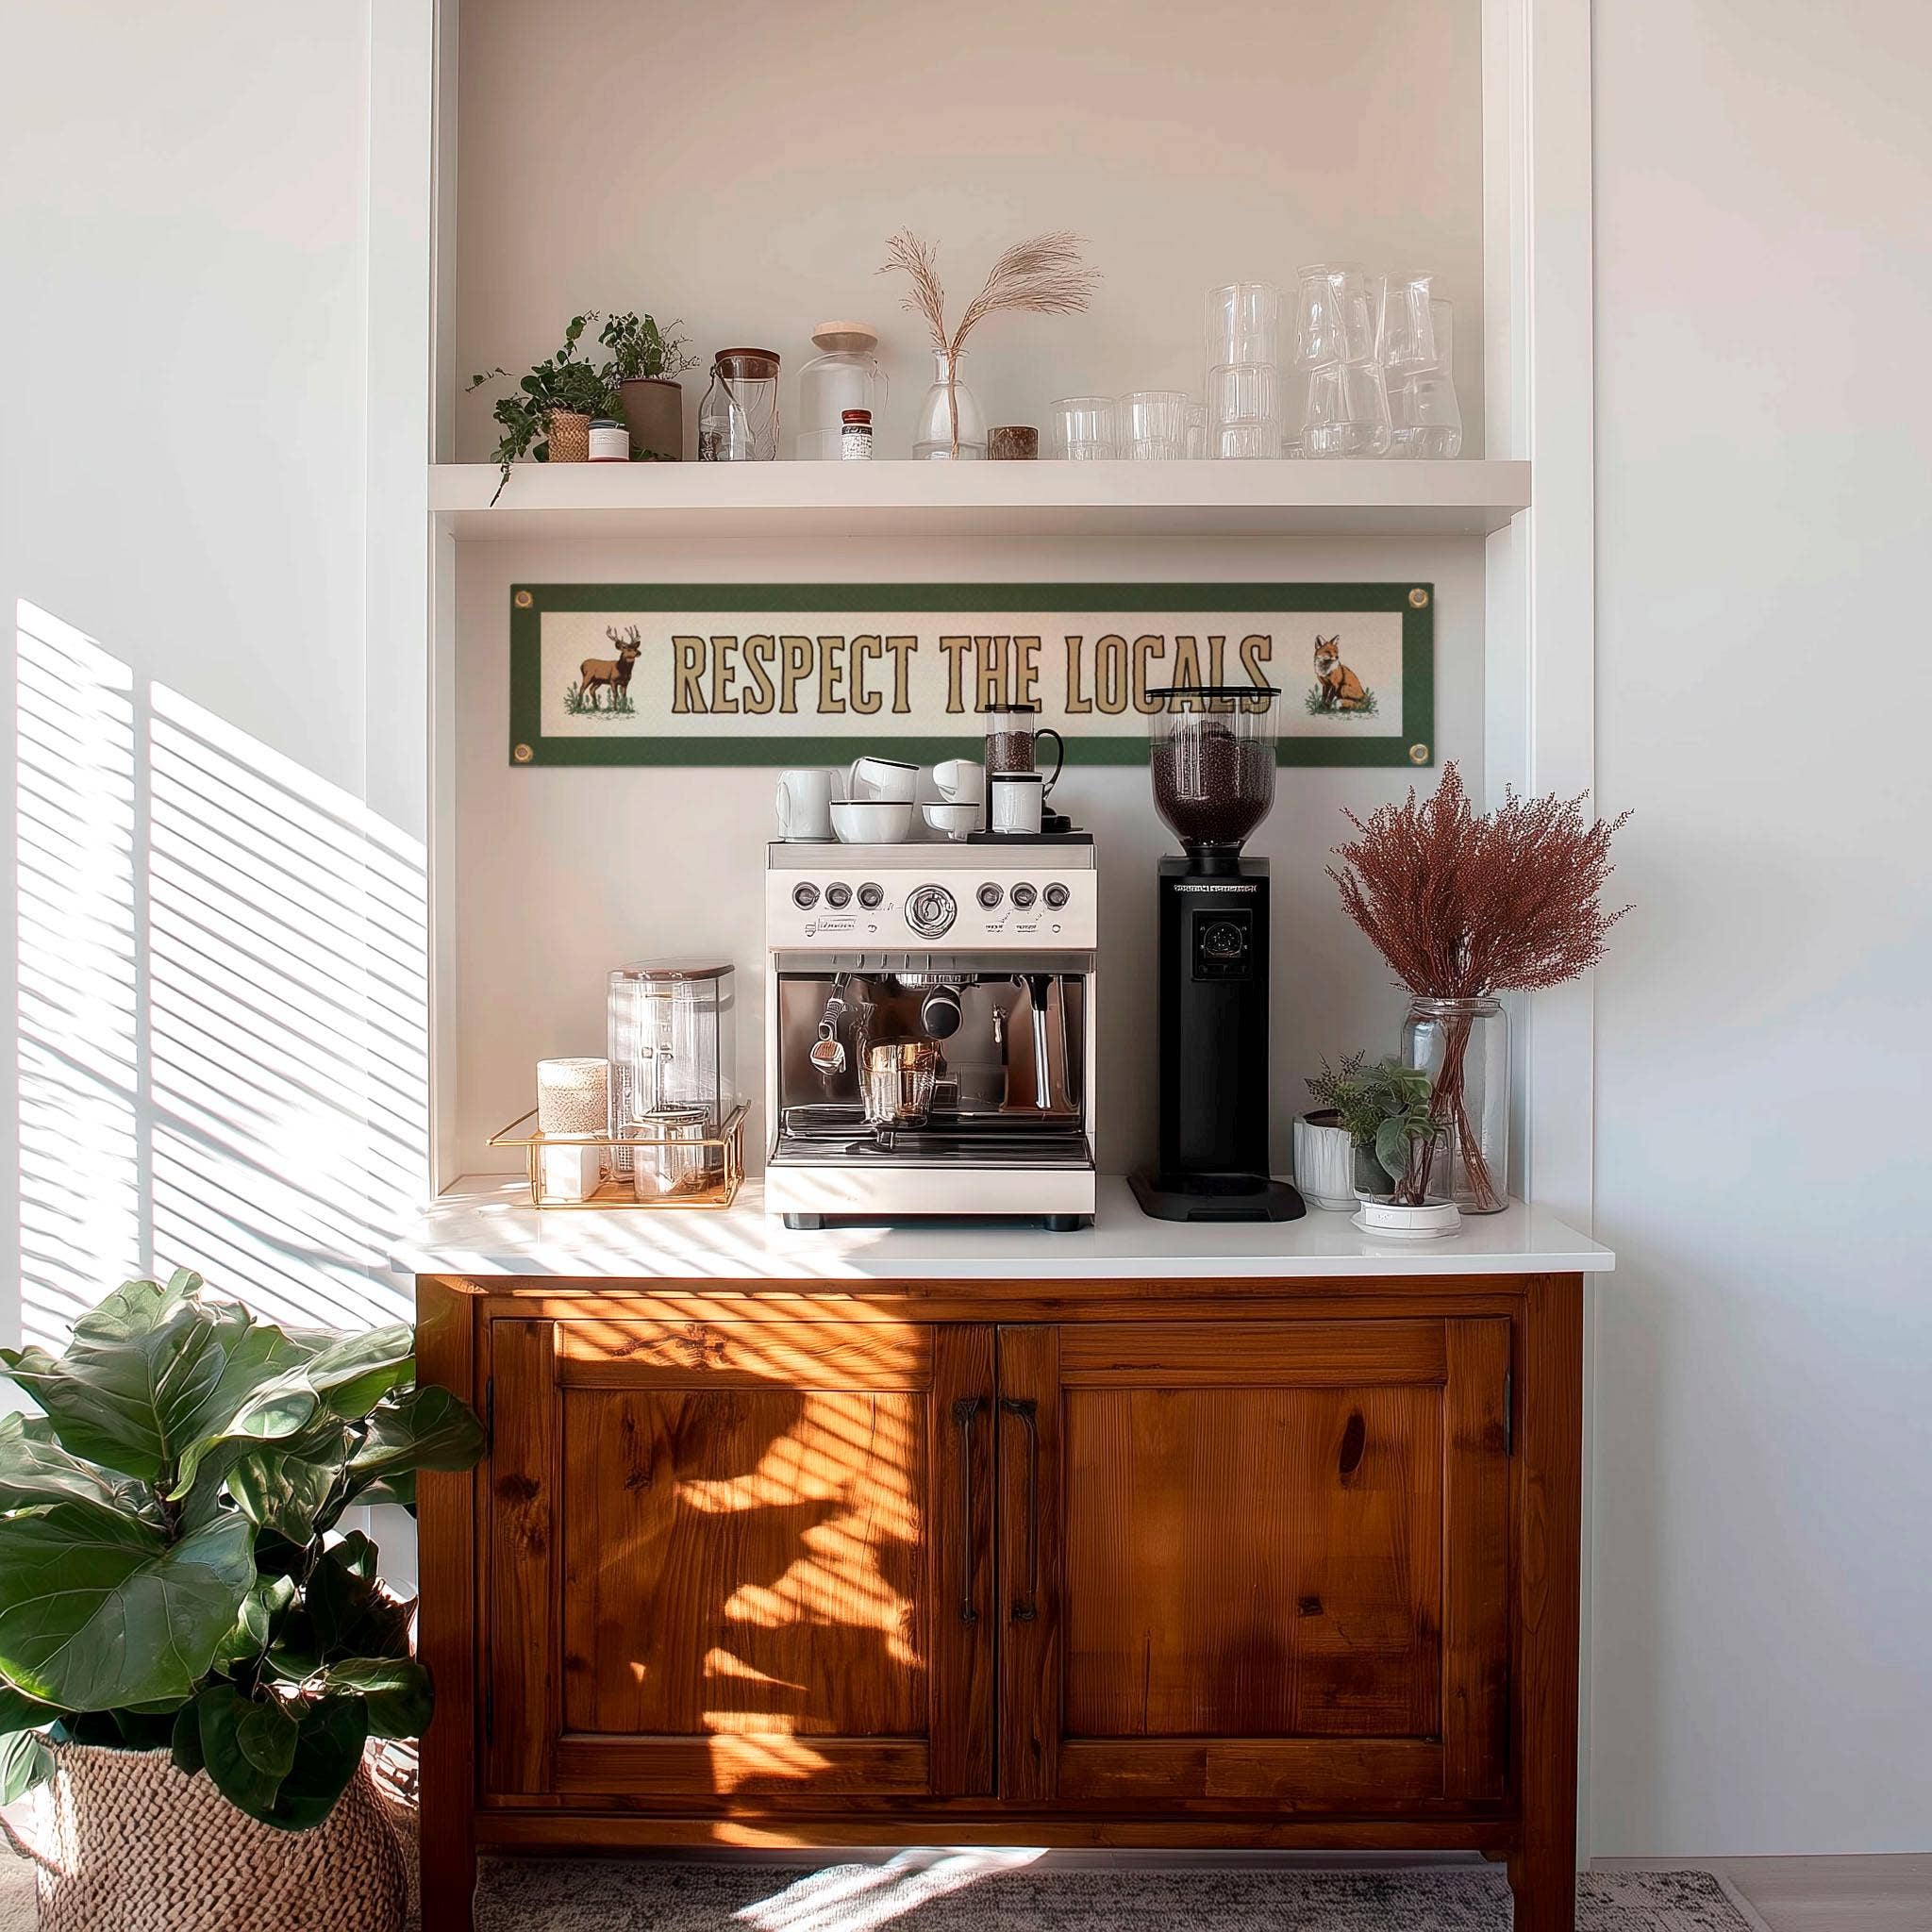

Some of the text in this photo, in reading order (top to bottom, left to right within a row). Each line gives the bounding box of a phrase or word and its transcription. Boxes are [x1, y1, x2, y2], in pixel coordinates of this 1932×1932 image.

[672, 634, 1272, 714] RESPECT THE LOCALS
